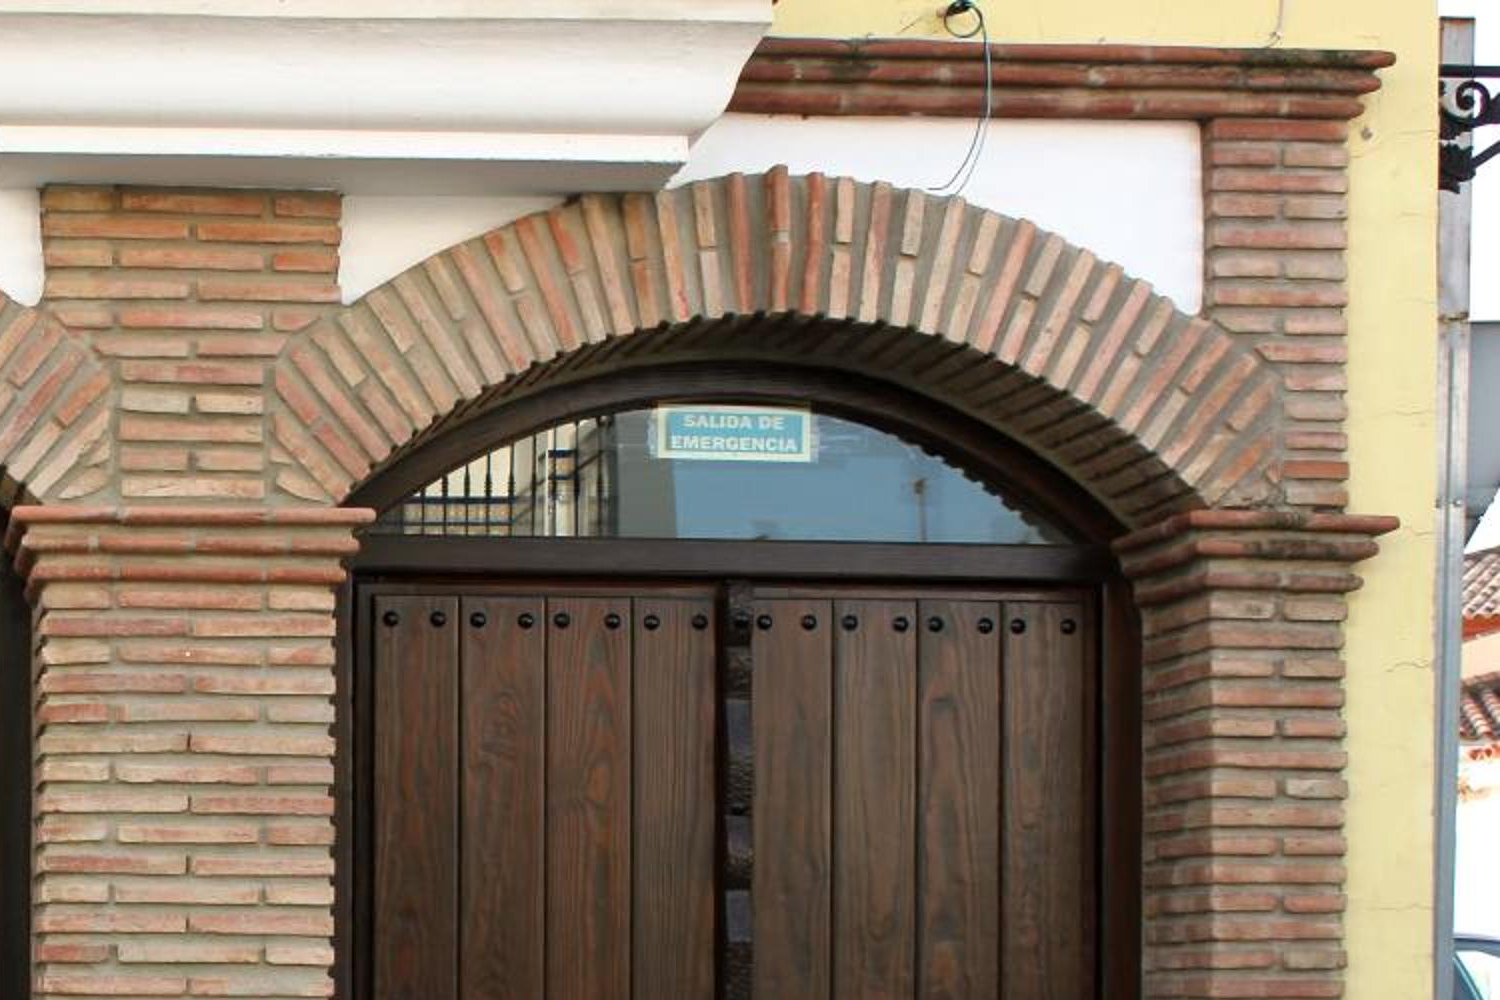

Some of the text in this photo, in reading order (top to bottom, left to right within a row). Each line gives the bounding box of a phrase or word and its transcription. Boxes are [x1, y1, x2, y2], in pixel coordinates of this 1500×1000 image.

[683, 414, 785, 431] SALIDA DE
[671, 435, 798, 452] EMERGENCIA
